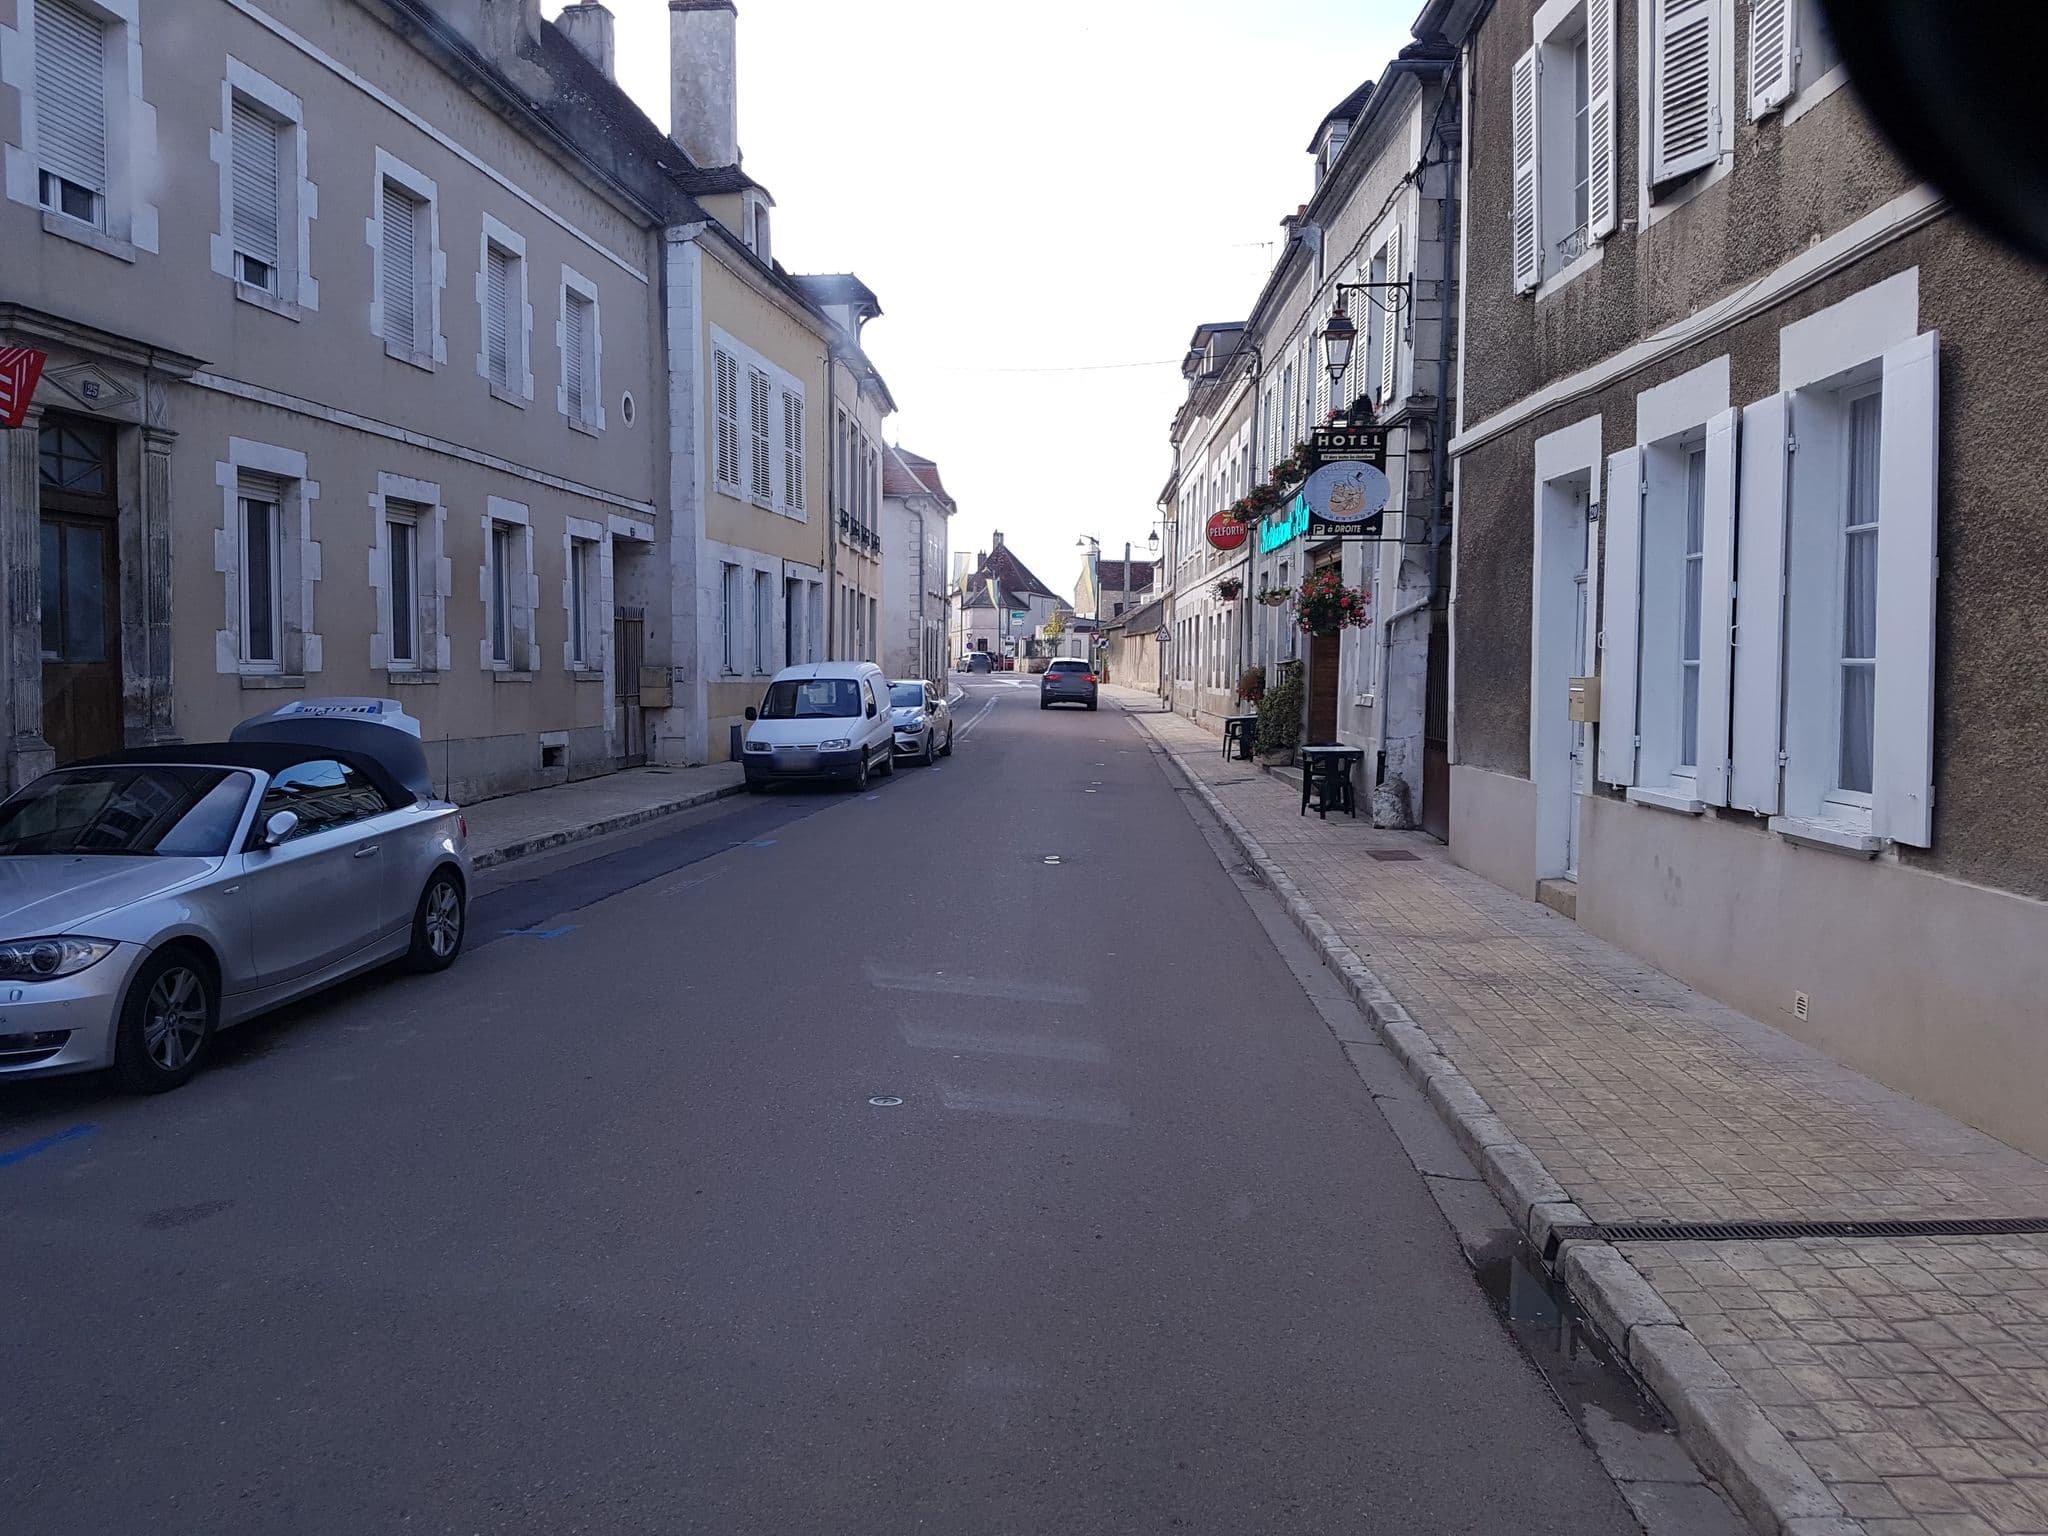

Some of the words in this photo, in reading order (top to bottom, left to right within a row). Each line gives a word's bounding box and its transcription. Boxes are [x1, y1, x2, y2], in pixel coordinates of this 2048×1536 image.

[1318, 434, 1381, 446] HOTEL
[1209, 524, 1245, 537] PELFORTH
[1334, 524, 1362, 533] DROITE
